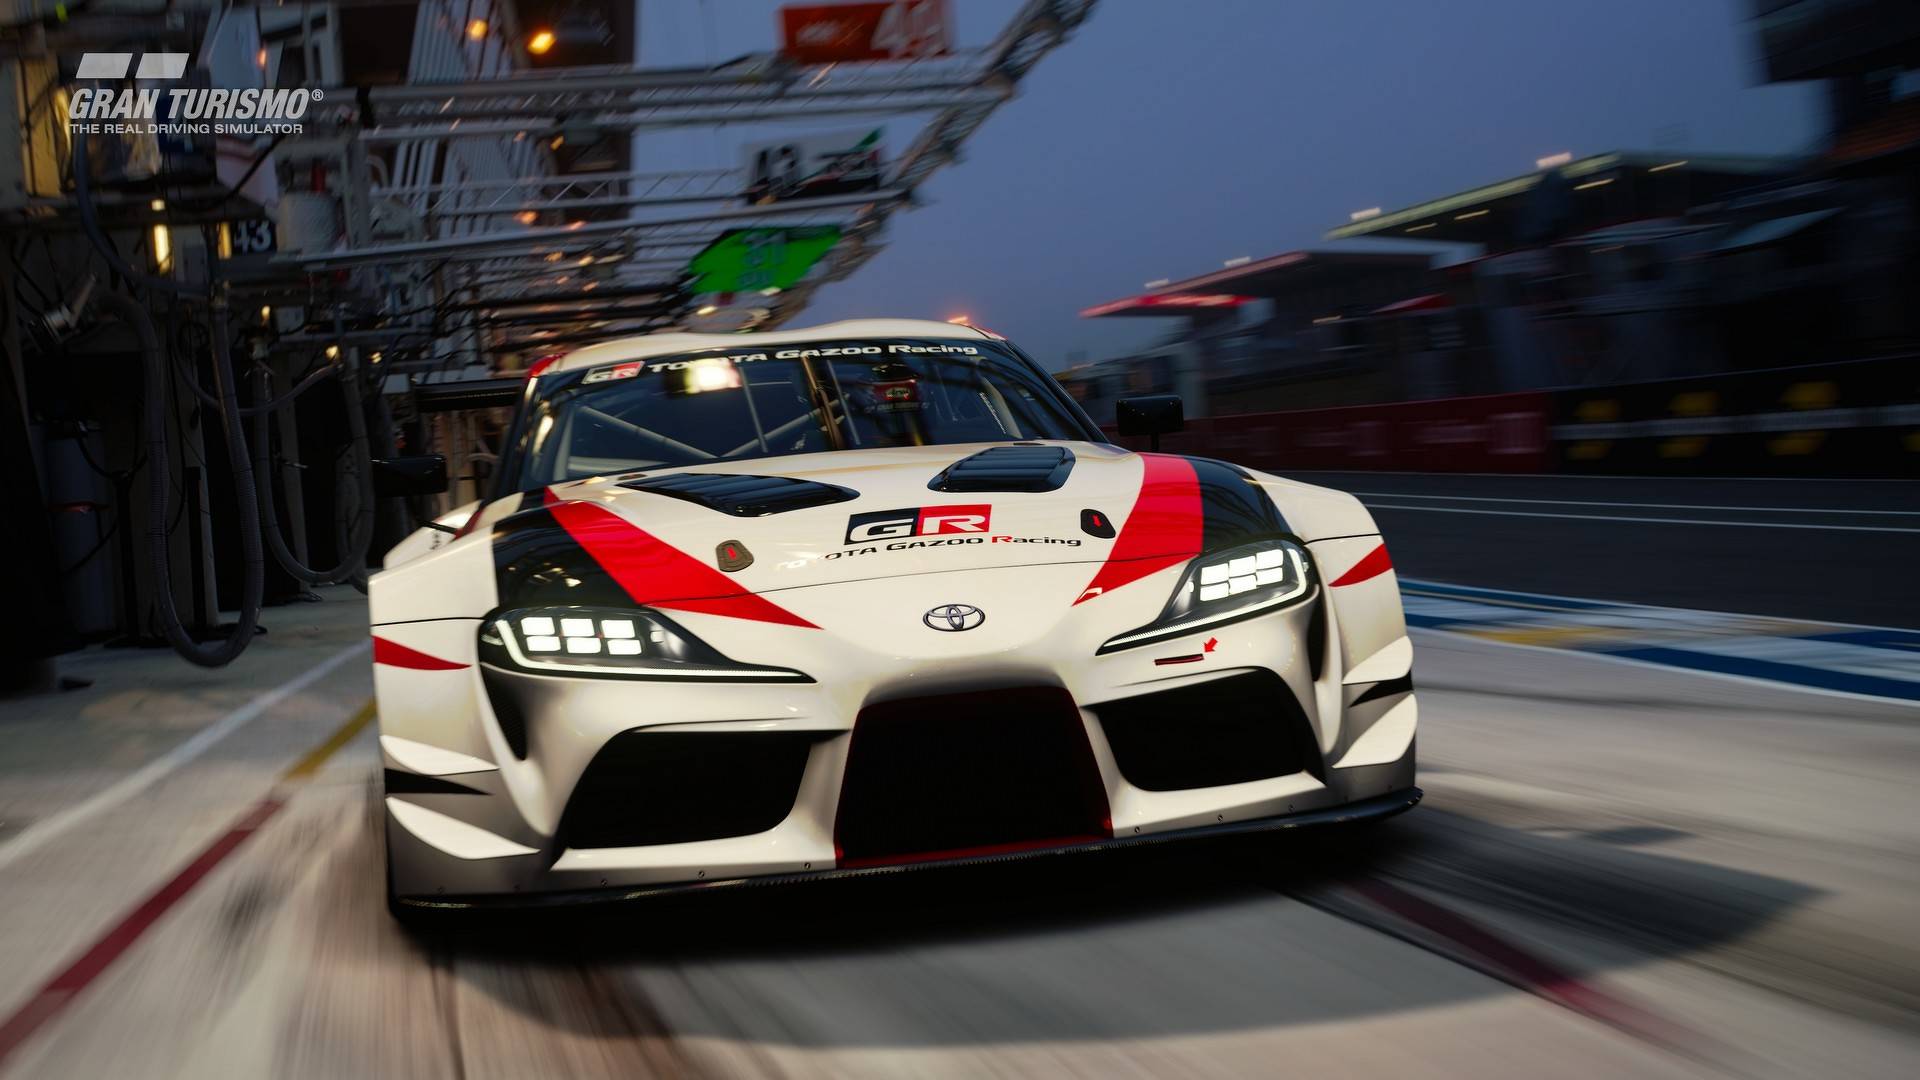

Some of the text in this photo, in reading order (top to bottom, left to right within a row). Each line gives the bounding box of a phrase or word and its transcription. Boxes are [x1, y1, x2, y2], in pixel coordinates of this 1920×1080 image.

[586, 365, 640, 384] GR
[775, 346, 882, 360] GAZOO
[888, 344, 978, 356] Racing
[848, 513, 987, 543] GR
[886, 537, 984, 551] GAZOO
[991, 535, 1081, 547] Racing
